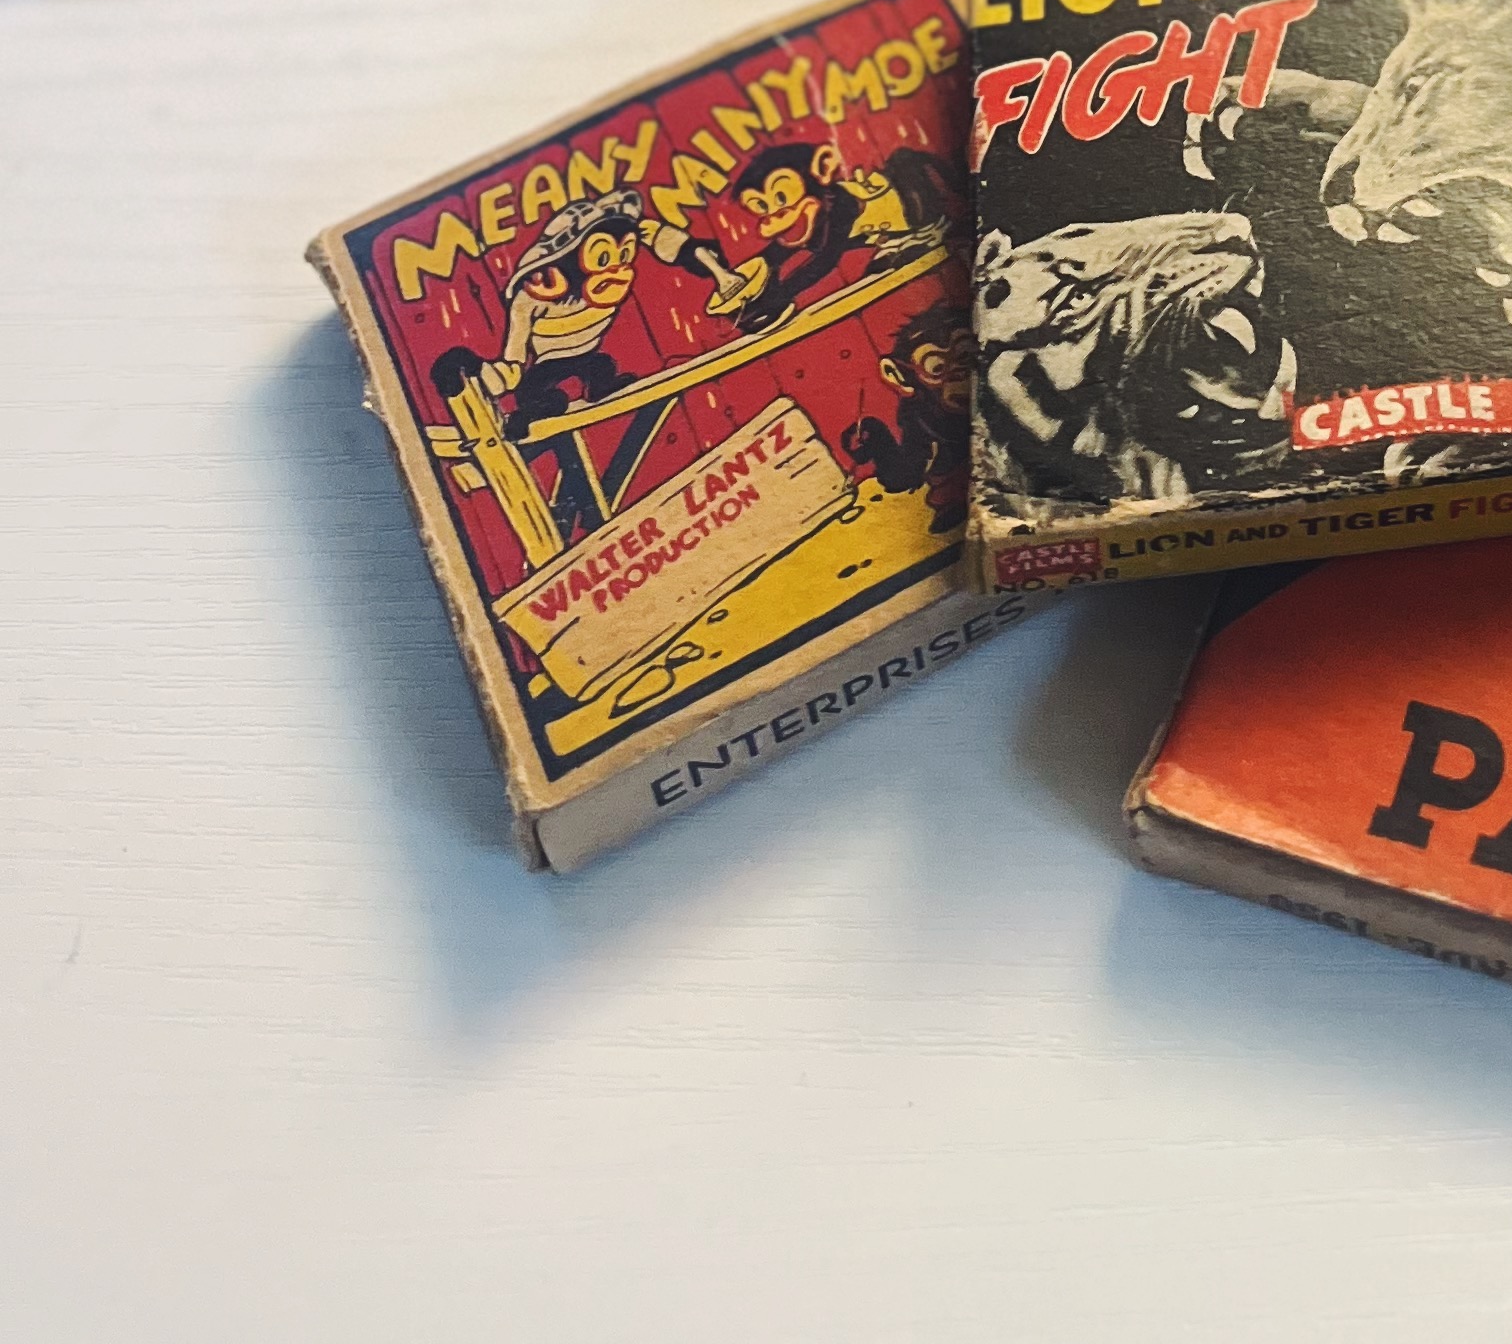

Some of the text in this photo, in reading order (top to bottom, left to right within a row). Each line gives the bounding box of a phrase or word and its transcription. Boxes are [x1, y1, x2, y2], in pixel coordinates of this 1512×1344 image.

[394, 17, 960, 300] MEANY MINY MOE
[1297, 384, 1495, 442] CASTLE
[528, 421, 795, 623] WALTER LANTZ
[593, 482, 760, 611] PRODUCTION
[998, 541, 1097, 563] CASTLE
[1008, 553, 1095, 575] FILMS
[1109, 529, 1215, 560] LION
[1227, 523, 1289, 544] AND
[1298, 502, 1435, 536] TIGER
[650, 595, 1025, 807] ENTERPRISES
